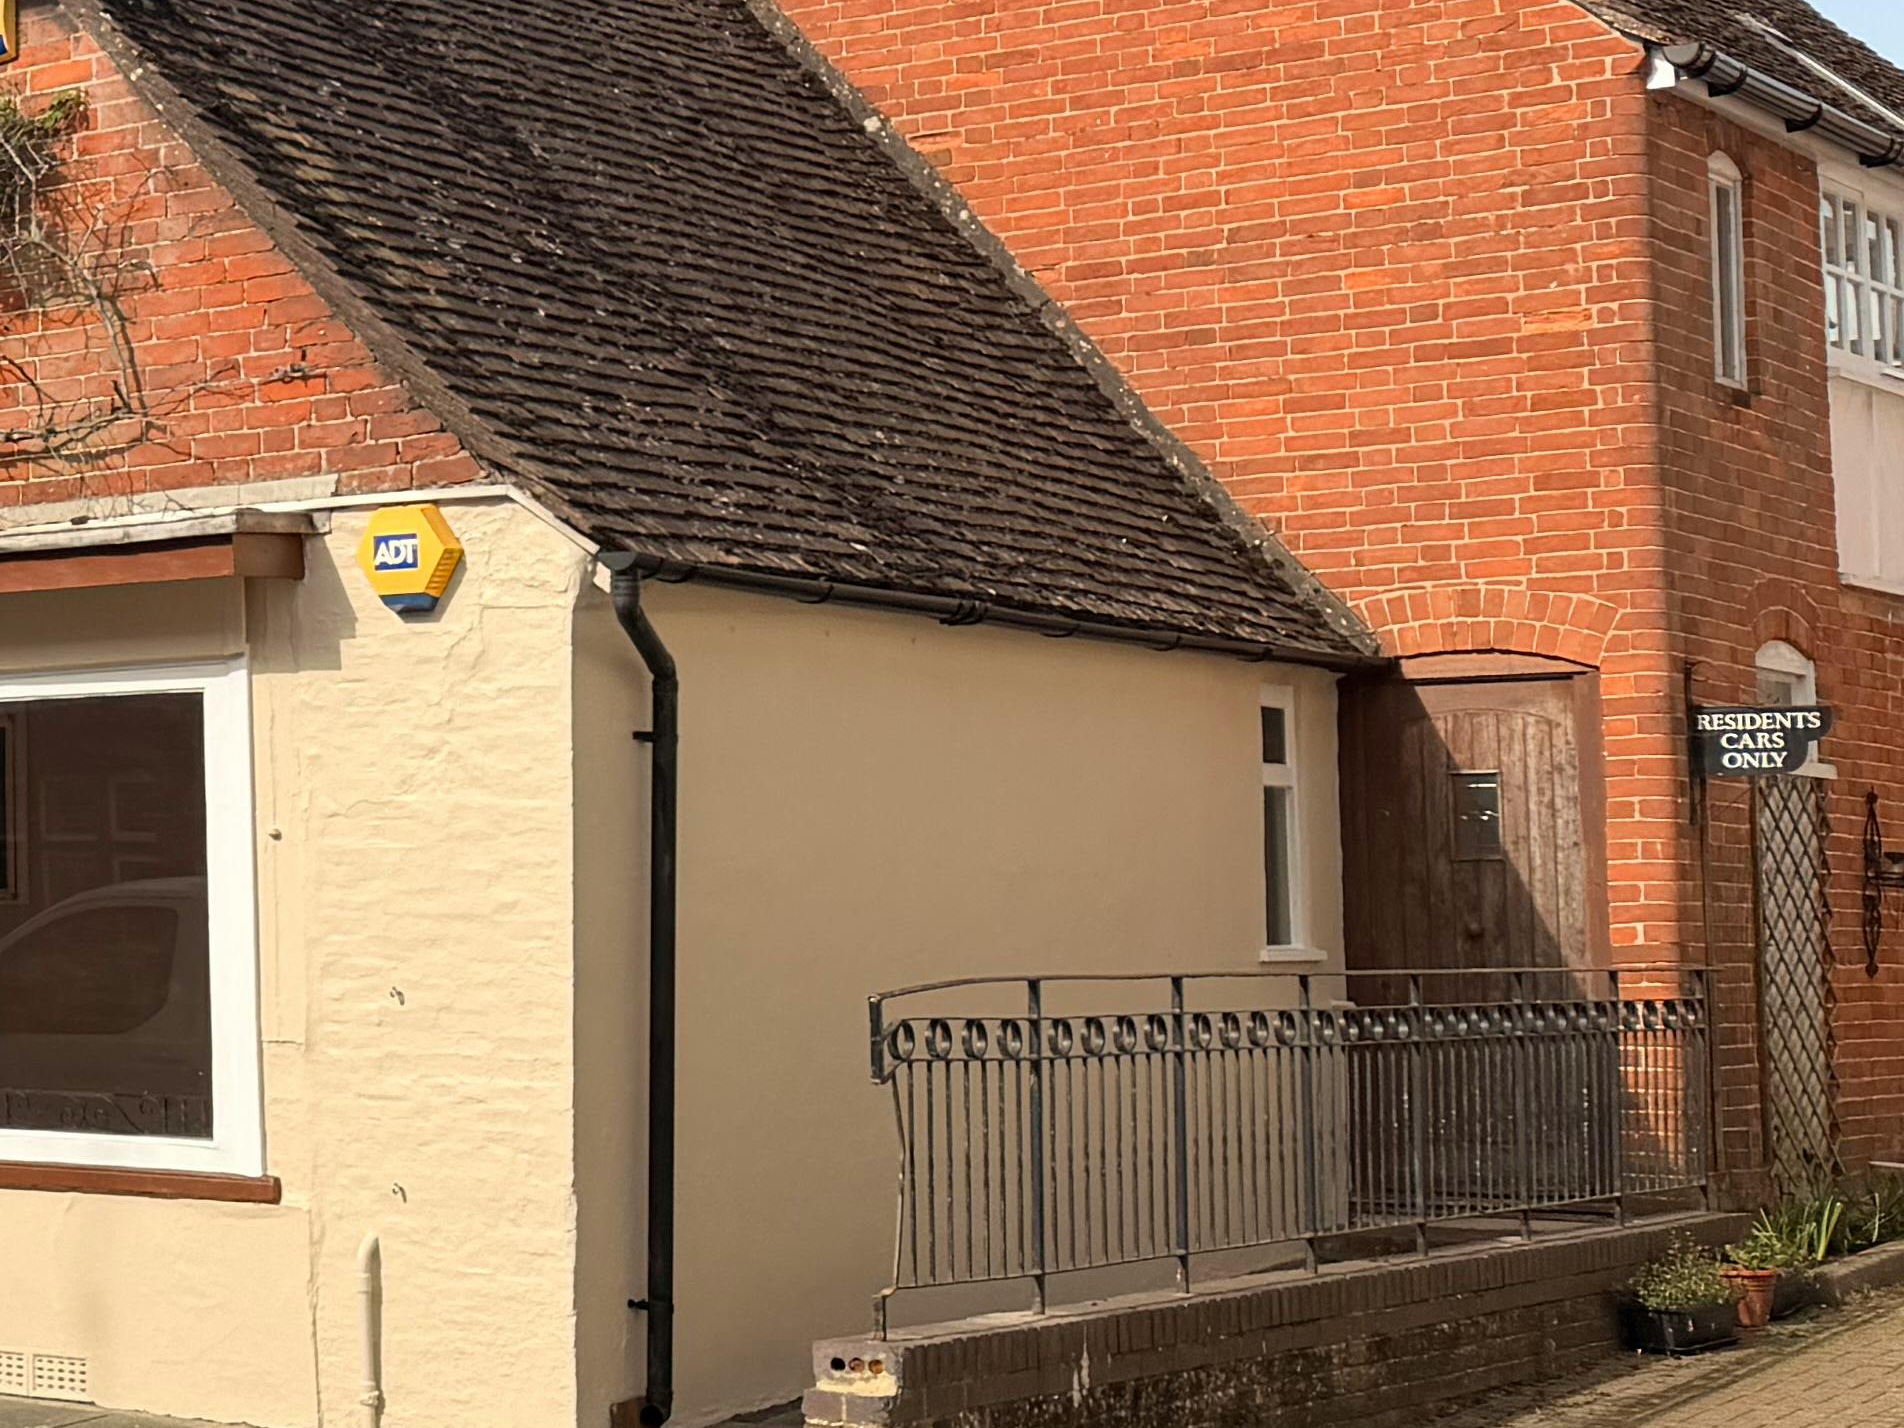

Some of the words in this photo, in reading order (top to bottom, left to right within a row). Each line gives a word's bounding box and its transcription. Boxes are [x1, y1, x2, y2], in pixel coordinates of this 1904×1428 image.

[374, 538, 417, 565] ADT
[1697, 712, 1821, 730] RESIDENTS
[1720, 732, 1785, 749] CARS
[1722, 751, 1788, 768] ONLY
